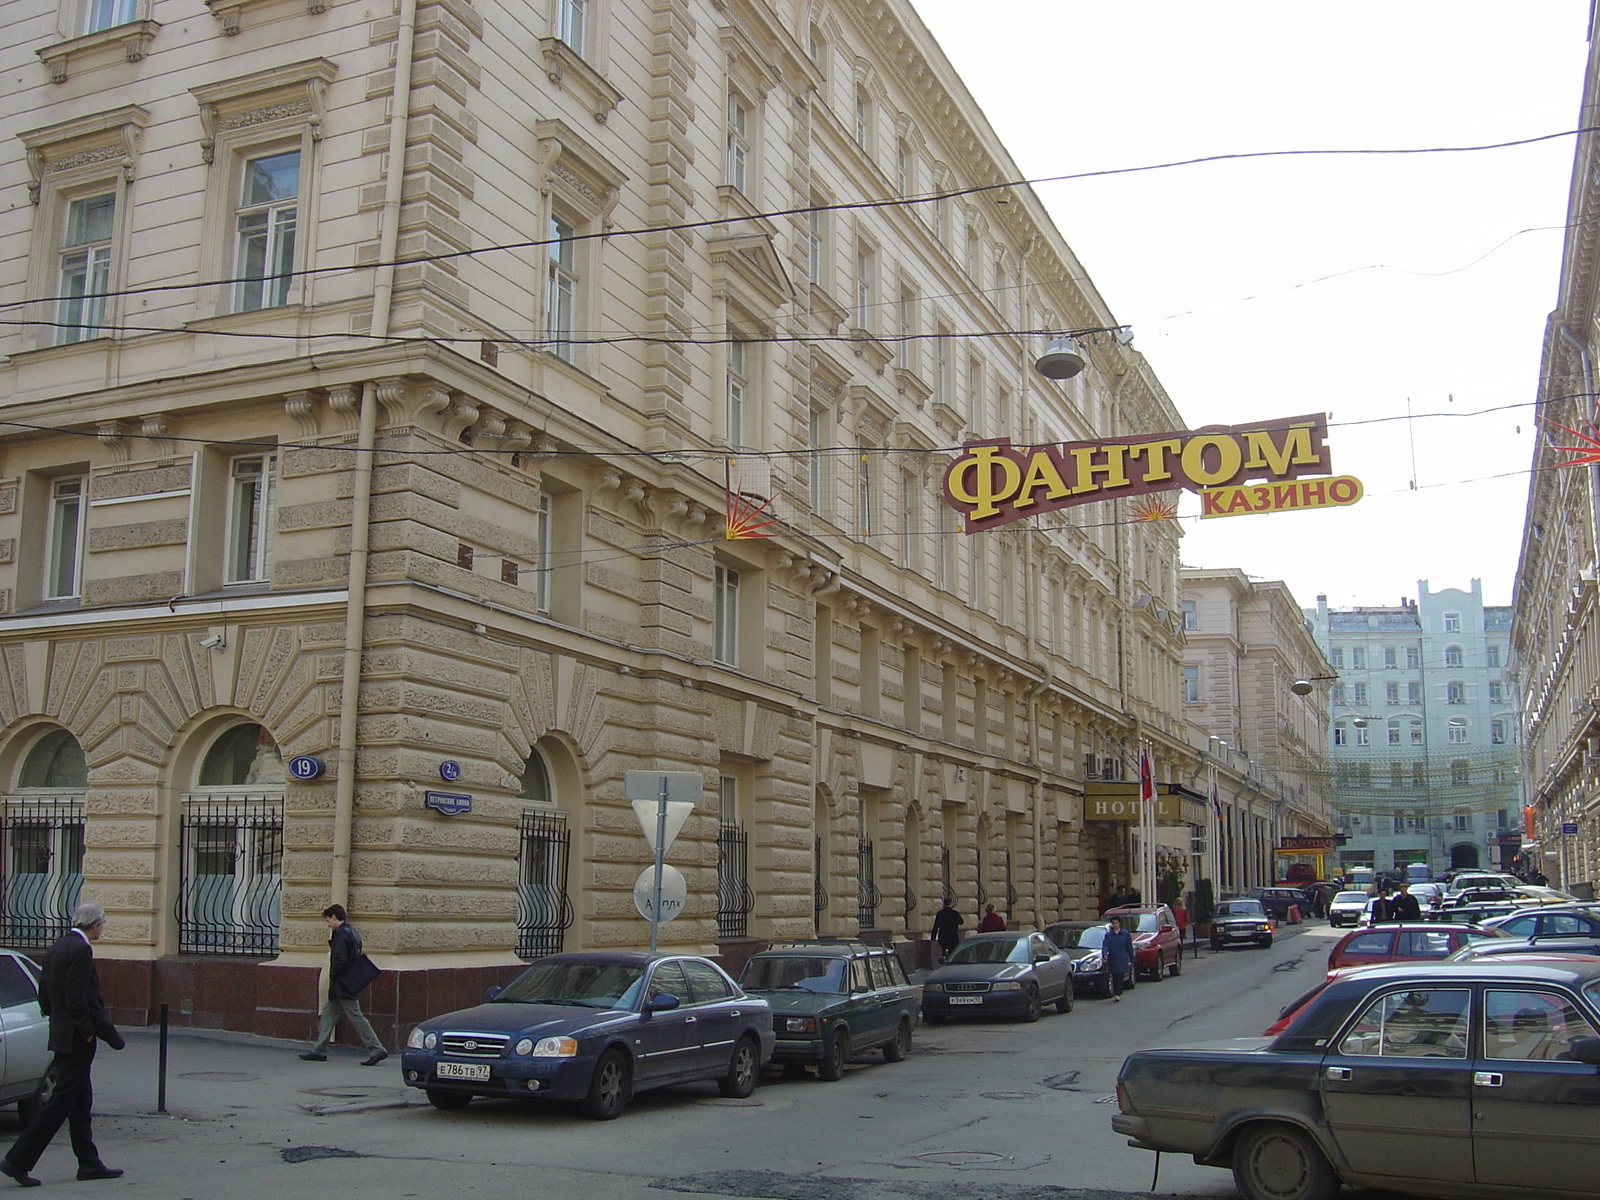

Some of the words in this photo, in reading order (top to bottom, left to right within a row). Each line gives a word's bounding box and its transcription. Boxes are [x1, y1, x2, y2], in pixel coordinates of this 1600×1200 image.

[948, 421, 1320, 521] ФАНТОМ
[1202, 478, 1358, 517] КАЗИНО
[298, 760, 311, 775] 19
[1096, 801, 1169, 815] HOTL
